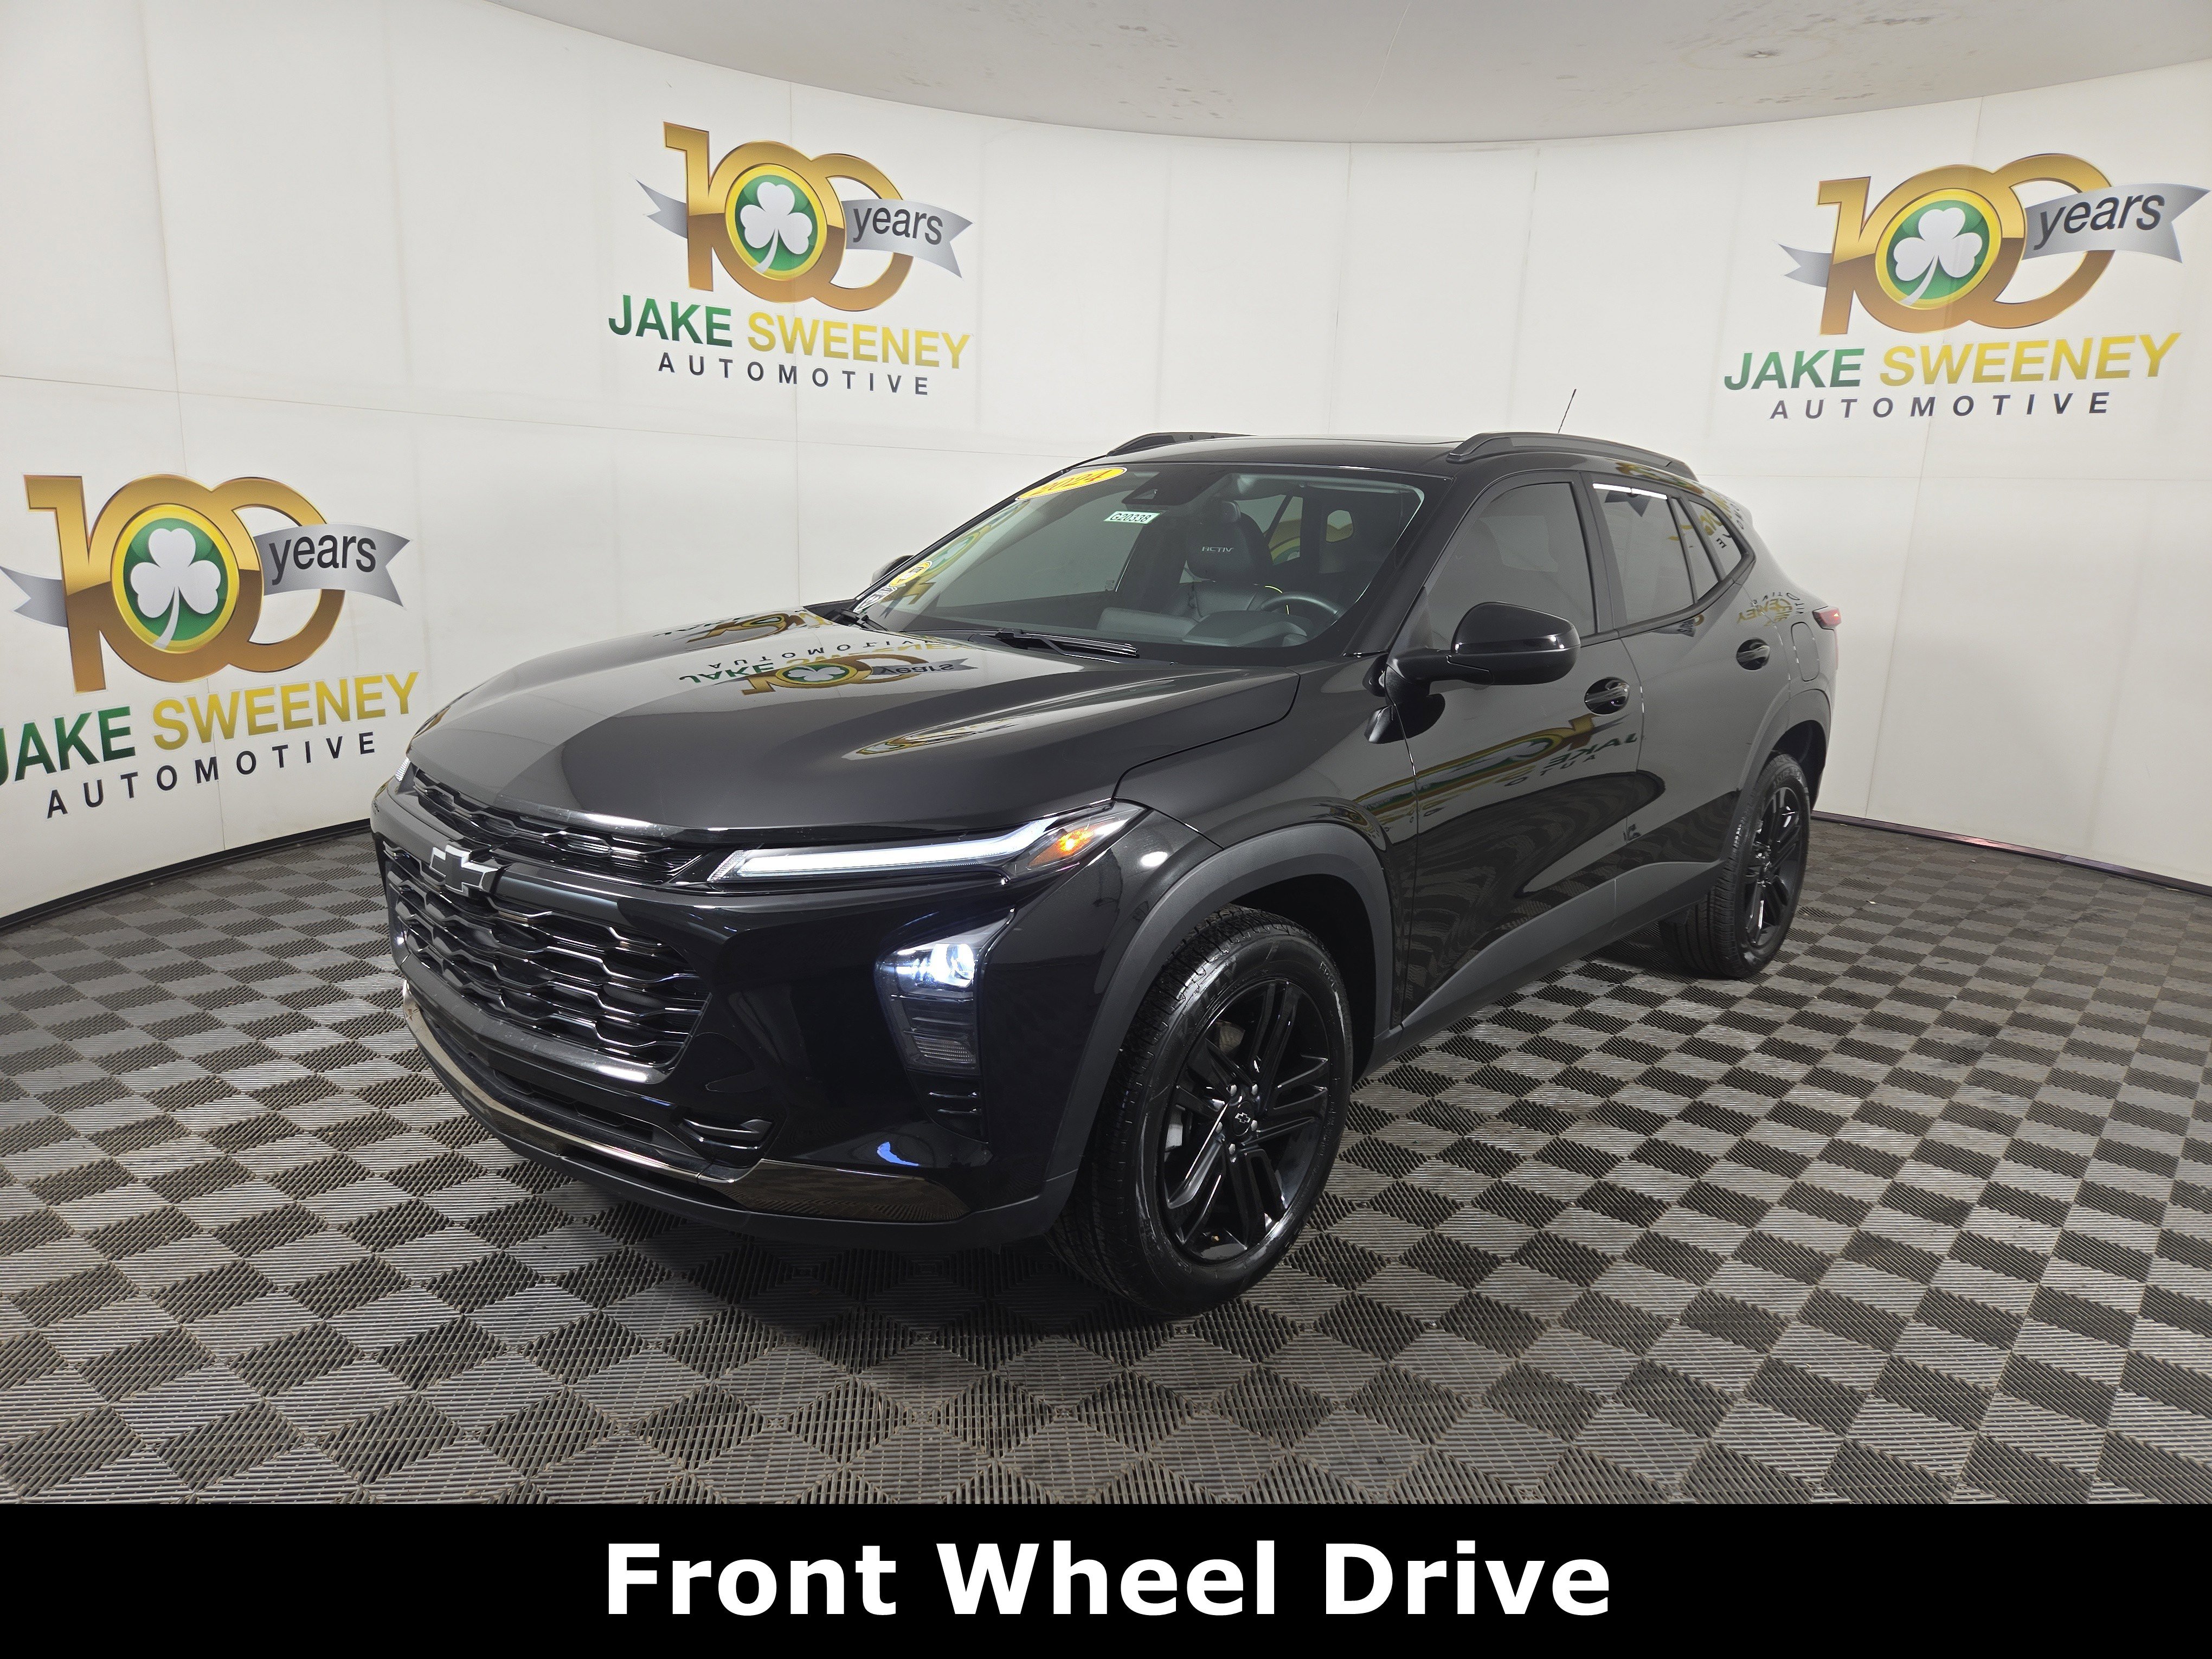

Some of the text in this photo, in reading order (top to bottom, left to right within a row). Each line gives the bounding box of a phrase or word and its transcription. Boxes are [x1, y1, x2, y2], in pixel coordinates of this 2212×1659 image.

[663, 121, 914, 312] 100
[852, 206, 943, 246] years
[1817, 152, 2116, 336] 100
[2033, 194, 2166, 250] years
[608, 294, 971, 369] JAKE SWEENEY
[658, 352, 929, 396] AUTOMOTIVE
[1724, 332, 2182, 391] JAKE SWEENEY
[1769, 392, 2111, 420] AUTOMOTIVE
[1030, 470, 1113, 496] 2024
[1110, 512, 1152, 523] G20338
[23, 474, 346, 694] 100
[269, 535, 377, 586] years
[152, 671, 420, 751] SWEENEY
[47, 731, 376, 819] AUTOMOTIVE
